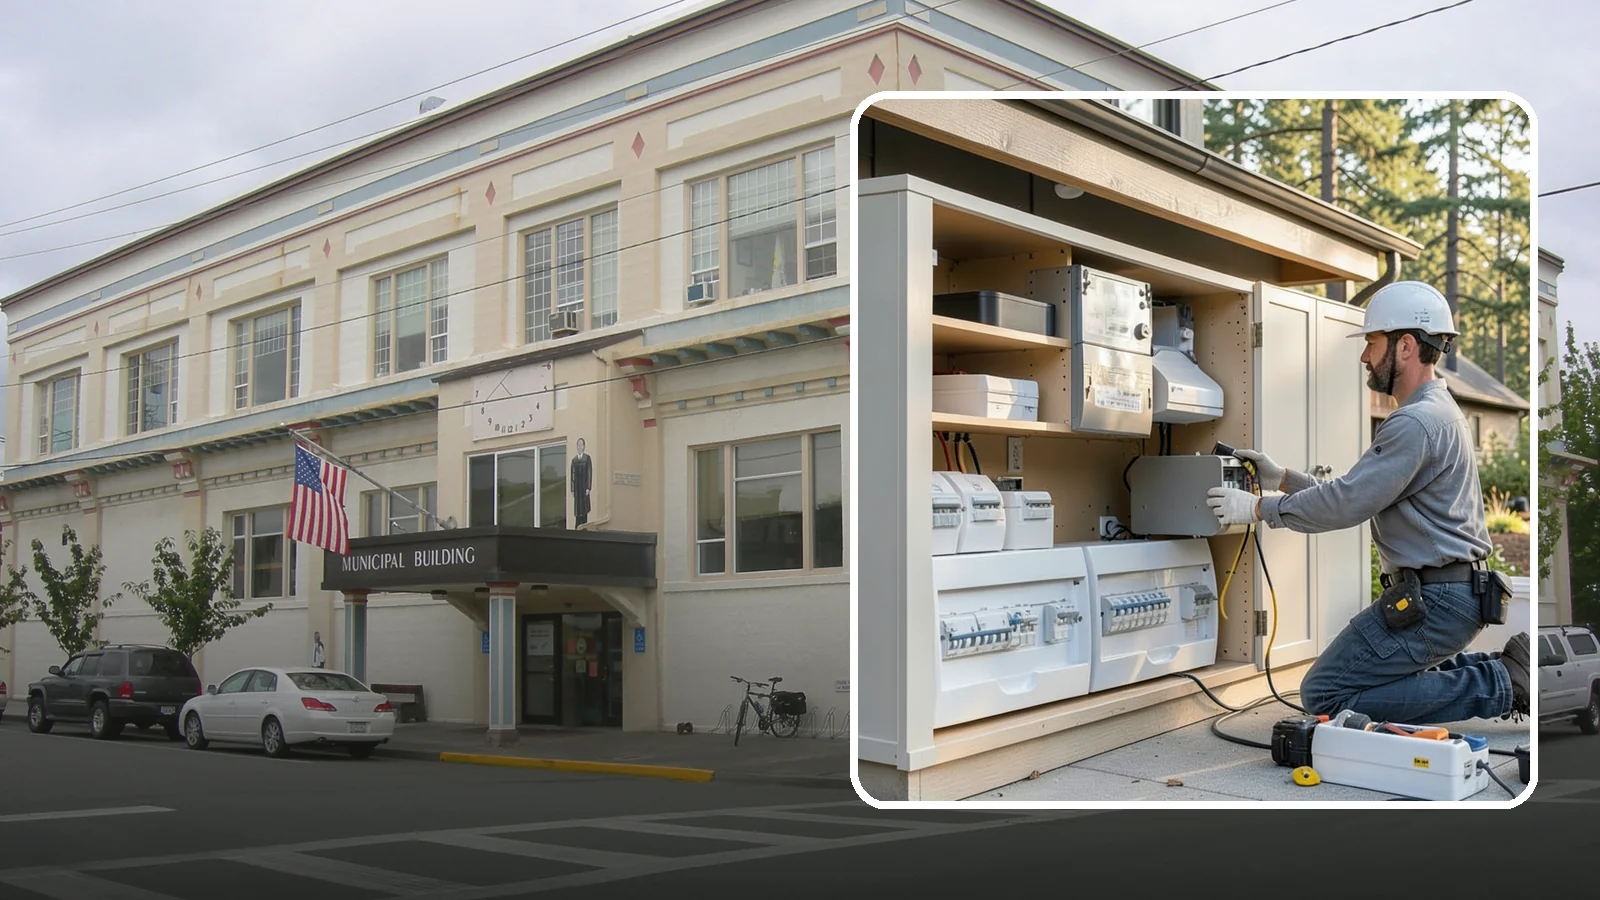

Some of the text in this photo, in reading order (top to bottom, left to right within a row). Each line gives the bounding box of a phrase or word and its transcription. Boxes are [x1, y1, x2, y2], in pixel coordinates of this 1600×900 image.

[475, 389, 479, 398] 7
[481, 407, 485, 415] 8
[487, 417, 492, 426] 9
[494, 424, 500, 432] 10
[507, 425, 513, 433] 12
[521, 420, 525, 428] 2
[529, 414, 533, 422] 3
[536, 402, 540, 410] 4
[342, 546, 475, 572] MUNICIPAL BUILDING
